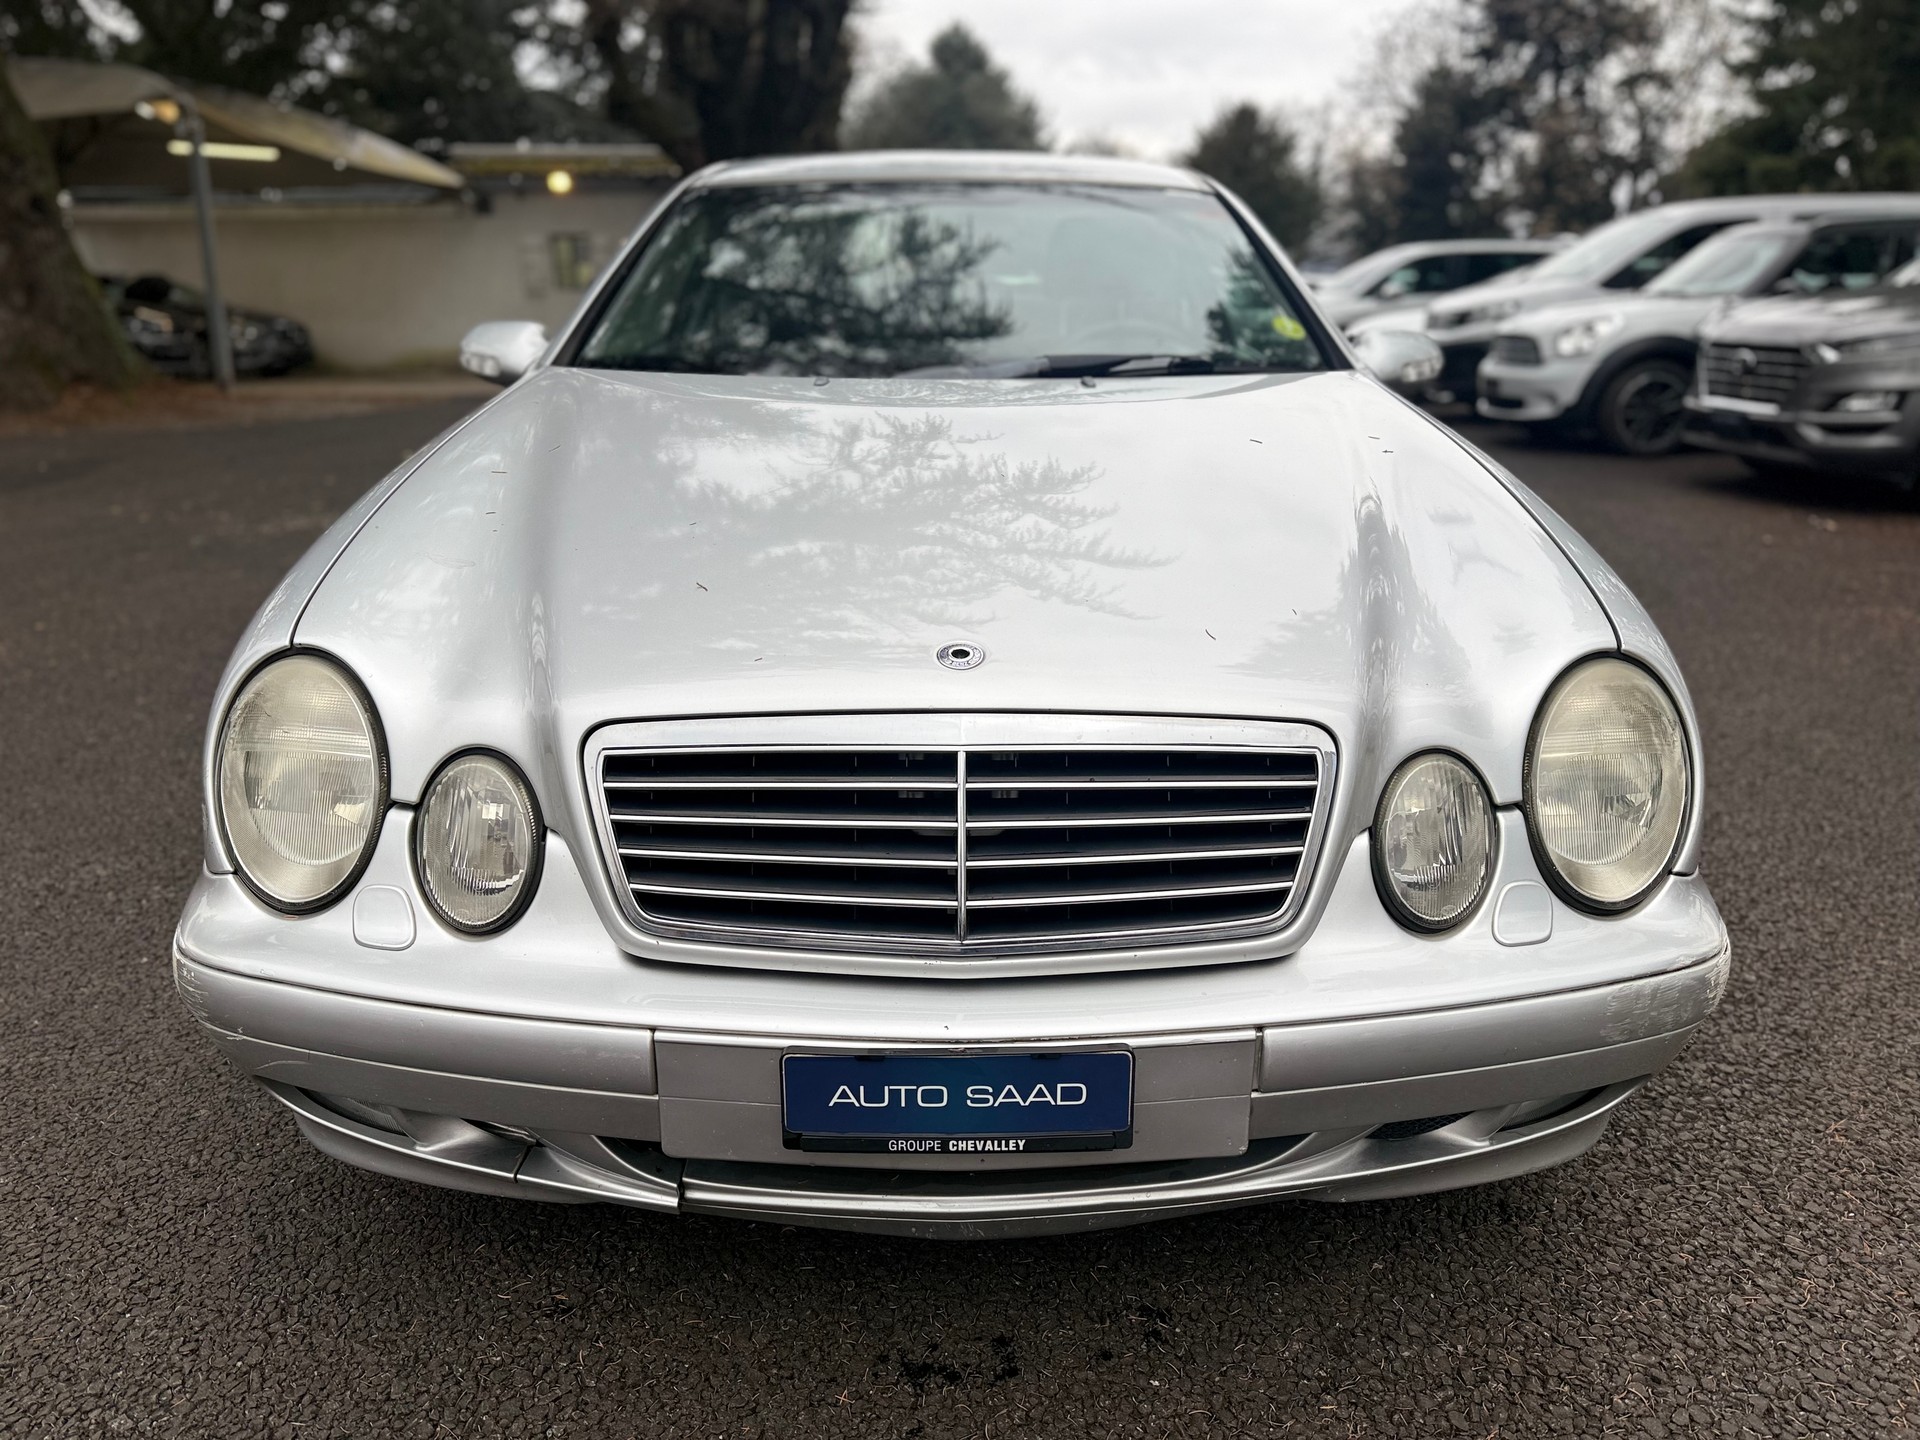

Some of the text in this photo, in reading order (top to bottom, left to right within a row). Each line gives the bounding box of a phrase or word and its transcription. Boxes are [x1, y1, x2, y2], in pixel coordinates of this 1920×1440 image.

[828, 1083, 1087, 1107] AUTO SAAD
[888, 1139, 1026, 1152] GROUPE CHEVALLEY
